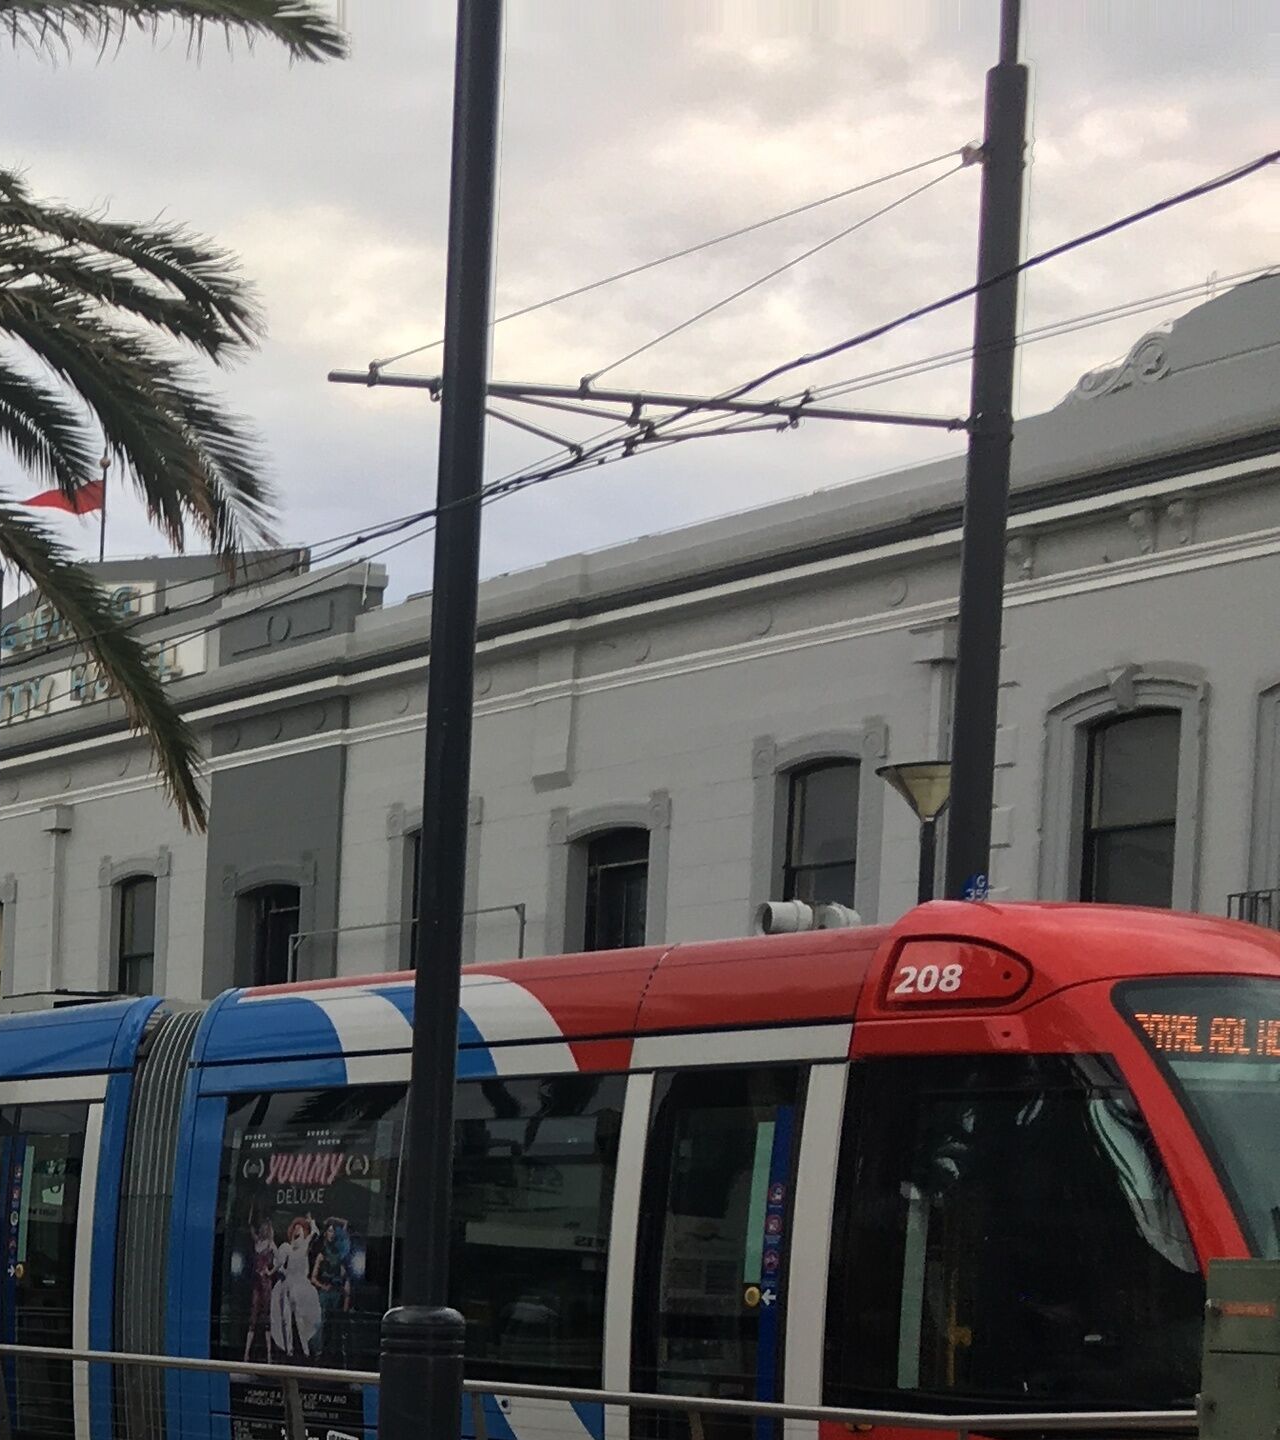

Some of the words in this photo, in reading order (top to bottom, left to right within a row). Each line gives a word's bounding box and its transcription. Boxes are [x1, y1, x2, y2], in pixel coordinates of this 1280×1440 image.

[894, 963, 963, 994] 208
[1209, 1017, 1251, 1054] ADL
[265, 1151, 345, 1185] YUMMY
[276, 1187, 326, 1205] DELUXE
